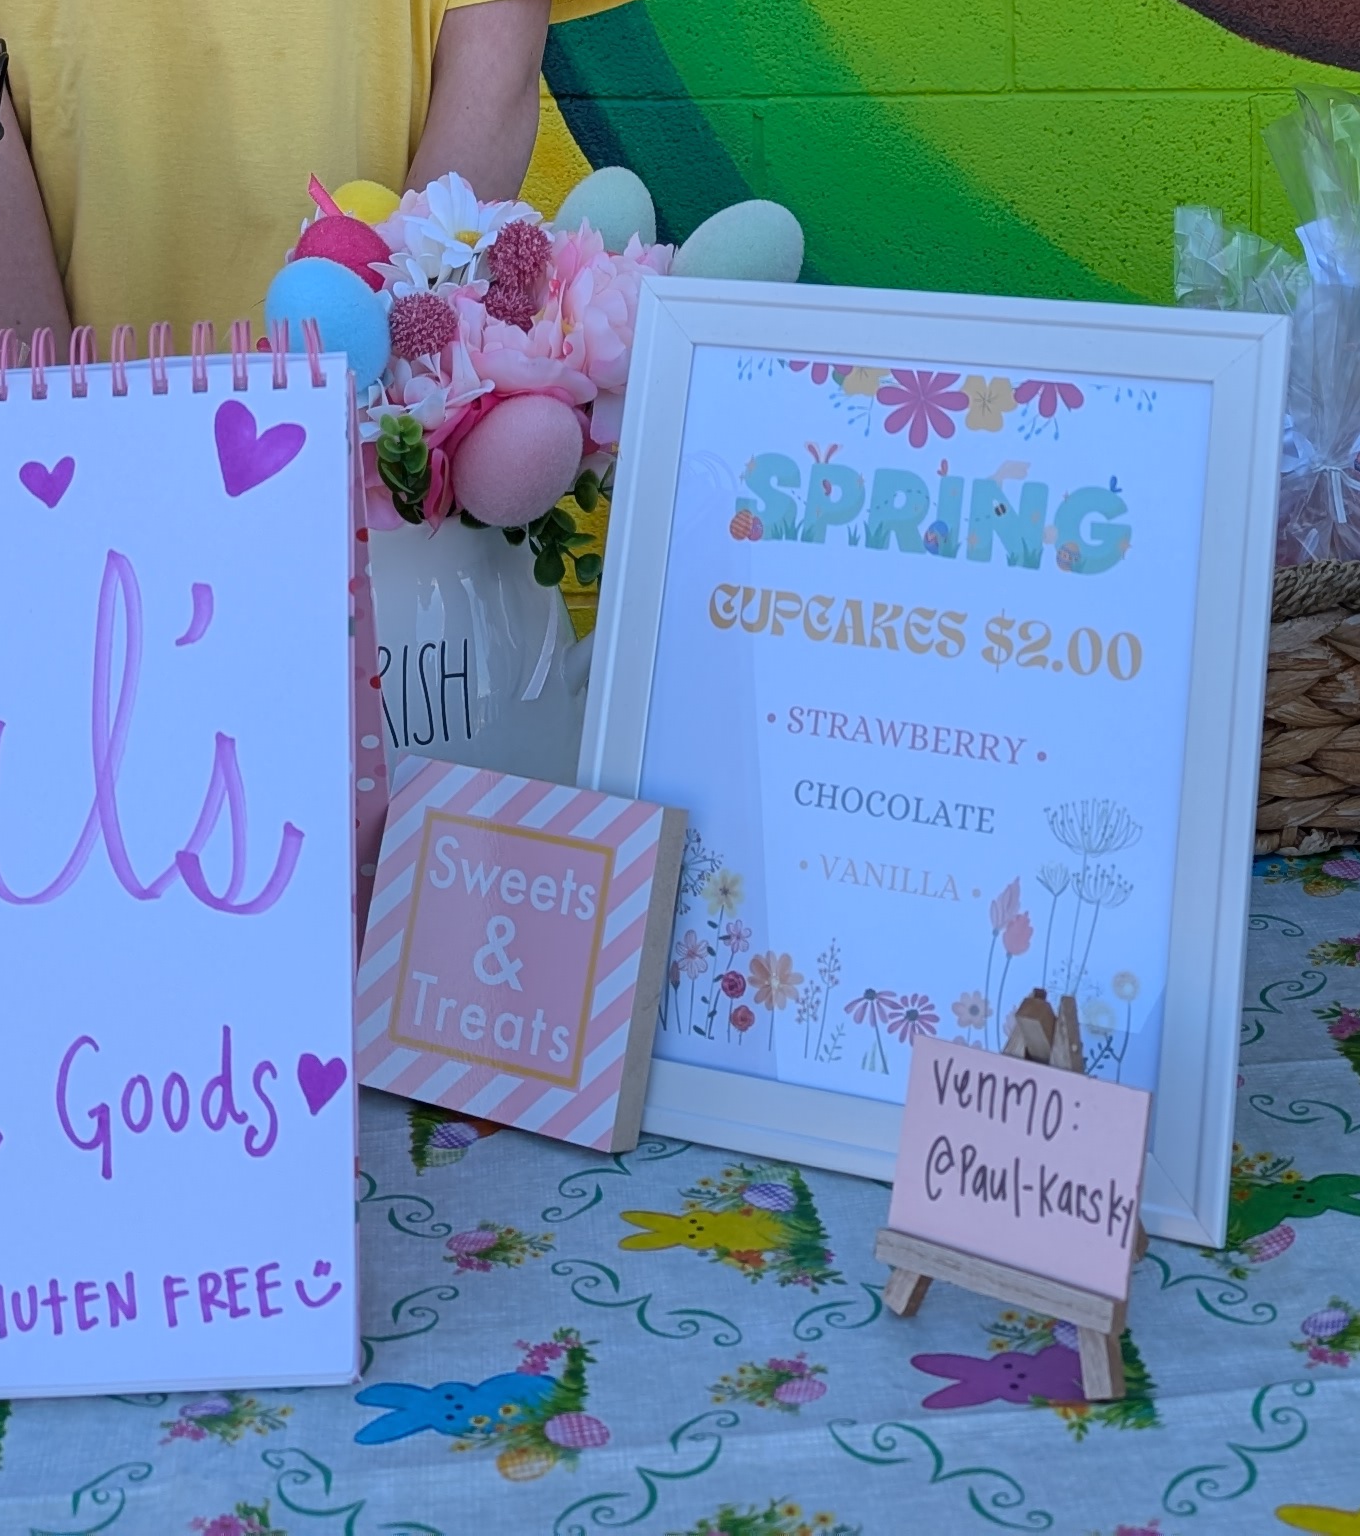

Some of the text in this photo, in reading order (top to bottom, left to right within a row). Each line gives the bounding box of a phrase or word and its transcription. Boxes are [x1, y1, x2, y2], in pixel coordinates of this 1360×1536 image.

[735, 452, 1133, 575] SPRING
[709, 582, 1143, 682] CUPCAKES $2.00
[786, 704, 1028, 765] STRAWBERRY
[793, 778, 997, 835] CHOCOLATE
[428, 834, 598, 921] Sweets
[819, 853, 962, 902] VANILLA
[472, 916, 524, 992] &
[411, 970, 571, 1063] Treats
[55, 1025, 280, 1180] Goods
[163, 1262, 282, 1327] FREE
